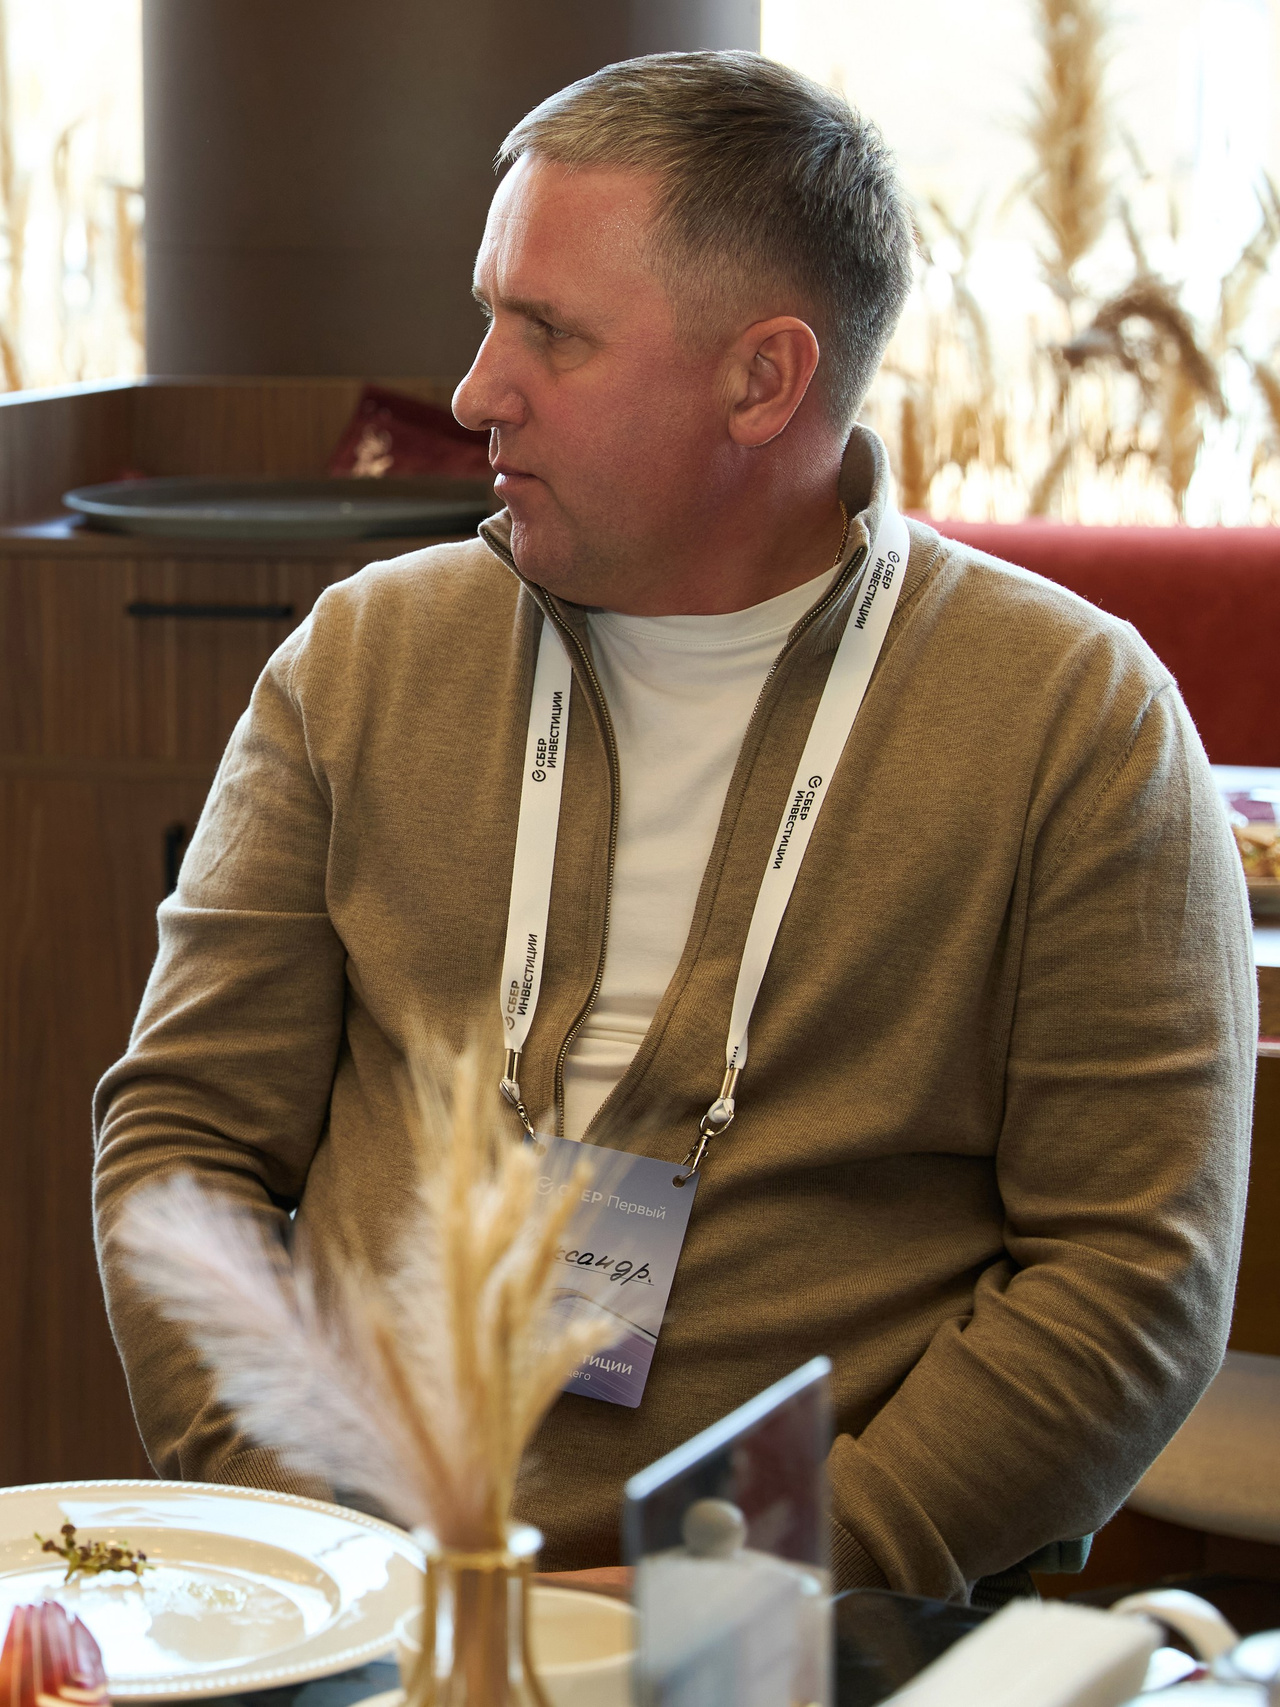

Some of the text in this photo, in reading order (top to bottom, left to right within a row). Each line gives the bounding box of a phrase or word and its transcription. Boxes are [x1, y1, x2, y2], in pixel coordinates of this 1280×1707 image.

[854, 557, 886, 630] ИНВЕСТИЦИИ
[882, 563, 896, 590] СБЕР
[547, 691, 563, 769] ИНВЕСТИЦИИ
[535, 738, 547, 767] СБЕР
[799, 791, 815, 821] СБЕР
[773, 790, 805, 870] ИНВЕСТИЦИИ
[517, 933, 538, 1016] ИНВЕСТИЦИИ
[507, 980, 520, 1014] СБЕР
[558, 1184, 666, 1220] СЕР Первый
